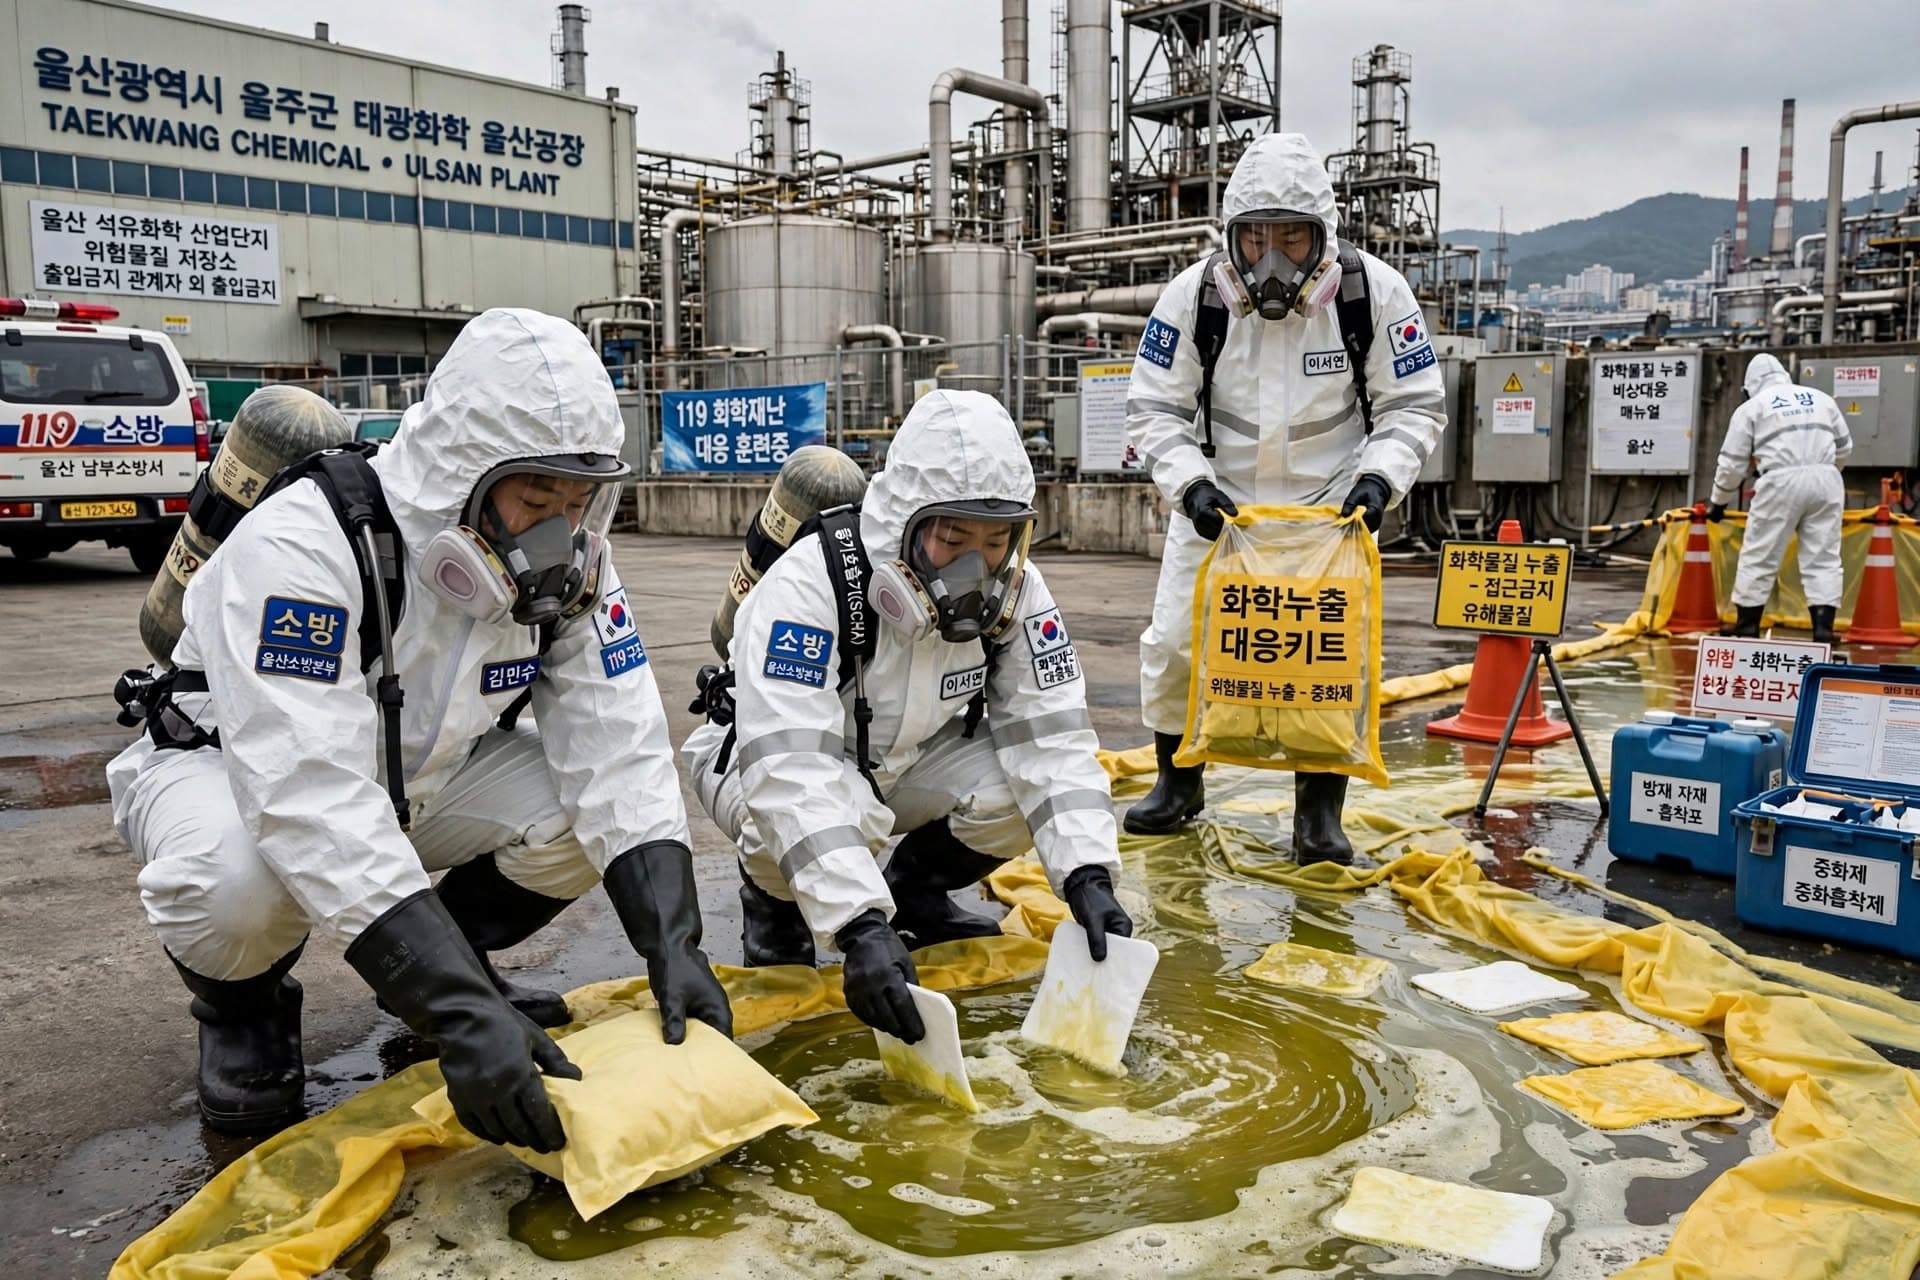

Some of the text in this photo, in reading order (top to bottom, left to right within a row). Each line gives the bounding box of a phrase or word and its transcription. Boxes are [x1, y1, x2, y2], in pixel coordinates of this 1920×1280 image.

[33, 46, 585, 168] 울산광역시 울주군 태광화학 울산공장
[41, 102, 221, 151] TAEKWANG
[231, 129, 371, 172] CHEMICAL
[405, 153, 482, 186] ULSAN
[491, 166, 561, 196] PLANT
[40, 208, 269, 250] 울산 석유화학 산업단지
[84, 240, 238, 272] 위험물질 저장소
[43, 262, 276, 299] 출입금지 관계자 외 출입금지
[1308, 354, 1345, 370] 이서연
[1600, 360, 1688, 379] 화학물질 누출
[1613, 381, 1669, 399] 비상대응
[1771, 391, 1814, 409] 소방
[676, 400, 707, 428] 119
[18, 410, 164, 446] 119 소방
[695, 432, 789, 464] 대응 훈련중
[1626, 439, 1655, 455] 울산
[40, 459, 163, 478] 울산 남부소방서
[1449, 550, 1561, 575] 화학물질 누출
[1484, 577, 1554, 601] 접근금지
[1220, 584, 1348, 622] 화학누출
[1462, 603, 1532, 626] 유해물질
[271, 608, 340, 646] 소방
[775, 629, 827, 659] 소방
[1221, 627, 1347, 665] 대응키트
[261, 652, 337, 677] 울산소방본부
[1706, 648, 1735, 669] 위험
[1749, 651, 1814, 674] 화학누출
[488, 663, 536, 688] 김민수
[946, 670, 984, 693] 이서연
[1210, 678, 1263, 699] 위험물질
[1267, 682, 1296, 701] 누출
[1311, 684, 1352, 702] 중화제
[1643, 780, 1707, 803] 방재 자재
[1658, 803, 1703, 825] 흡착포
[1813, 857, 1867, 885] 중화제
[1794, 881, 1884, 916] 중화흡착제
